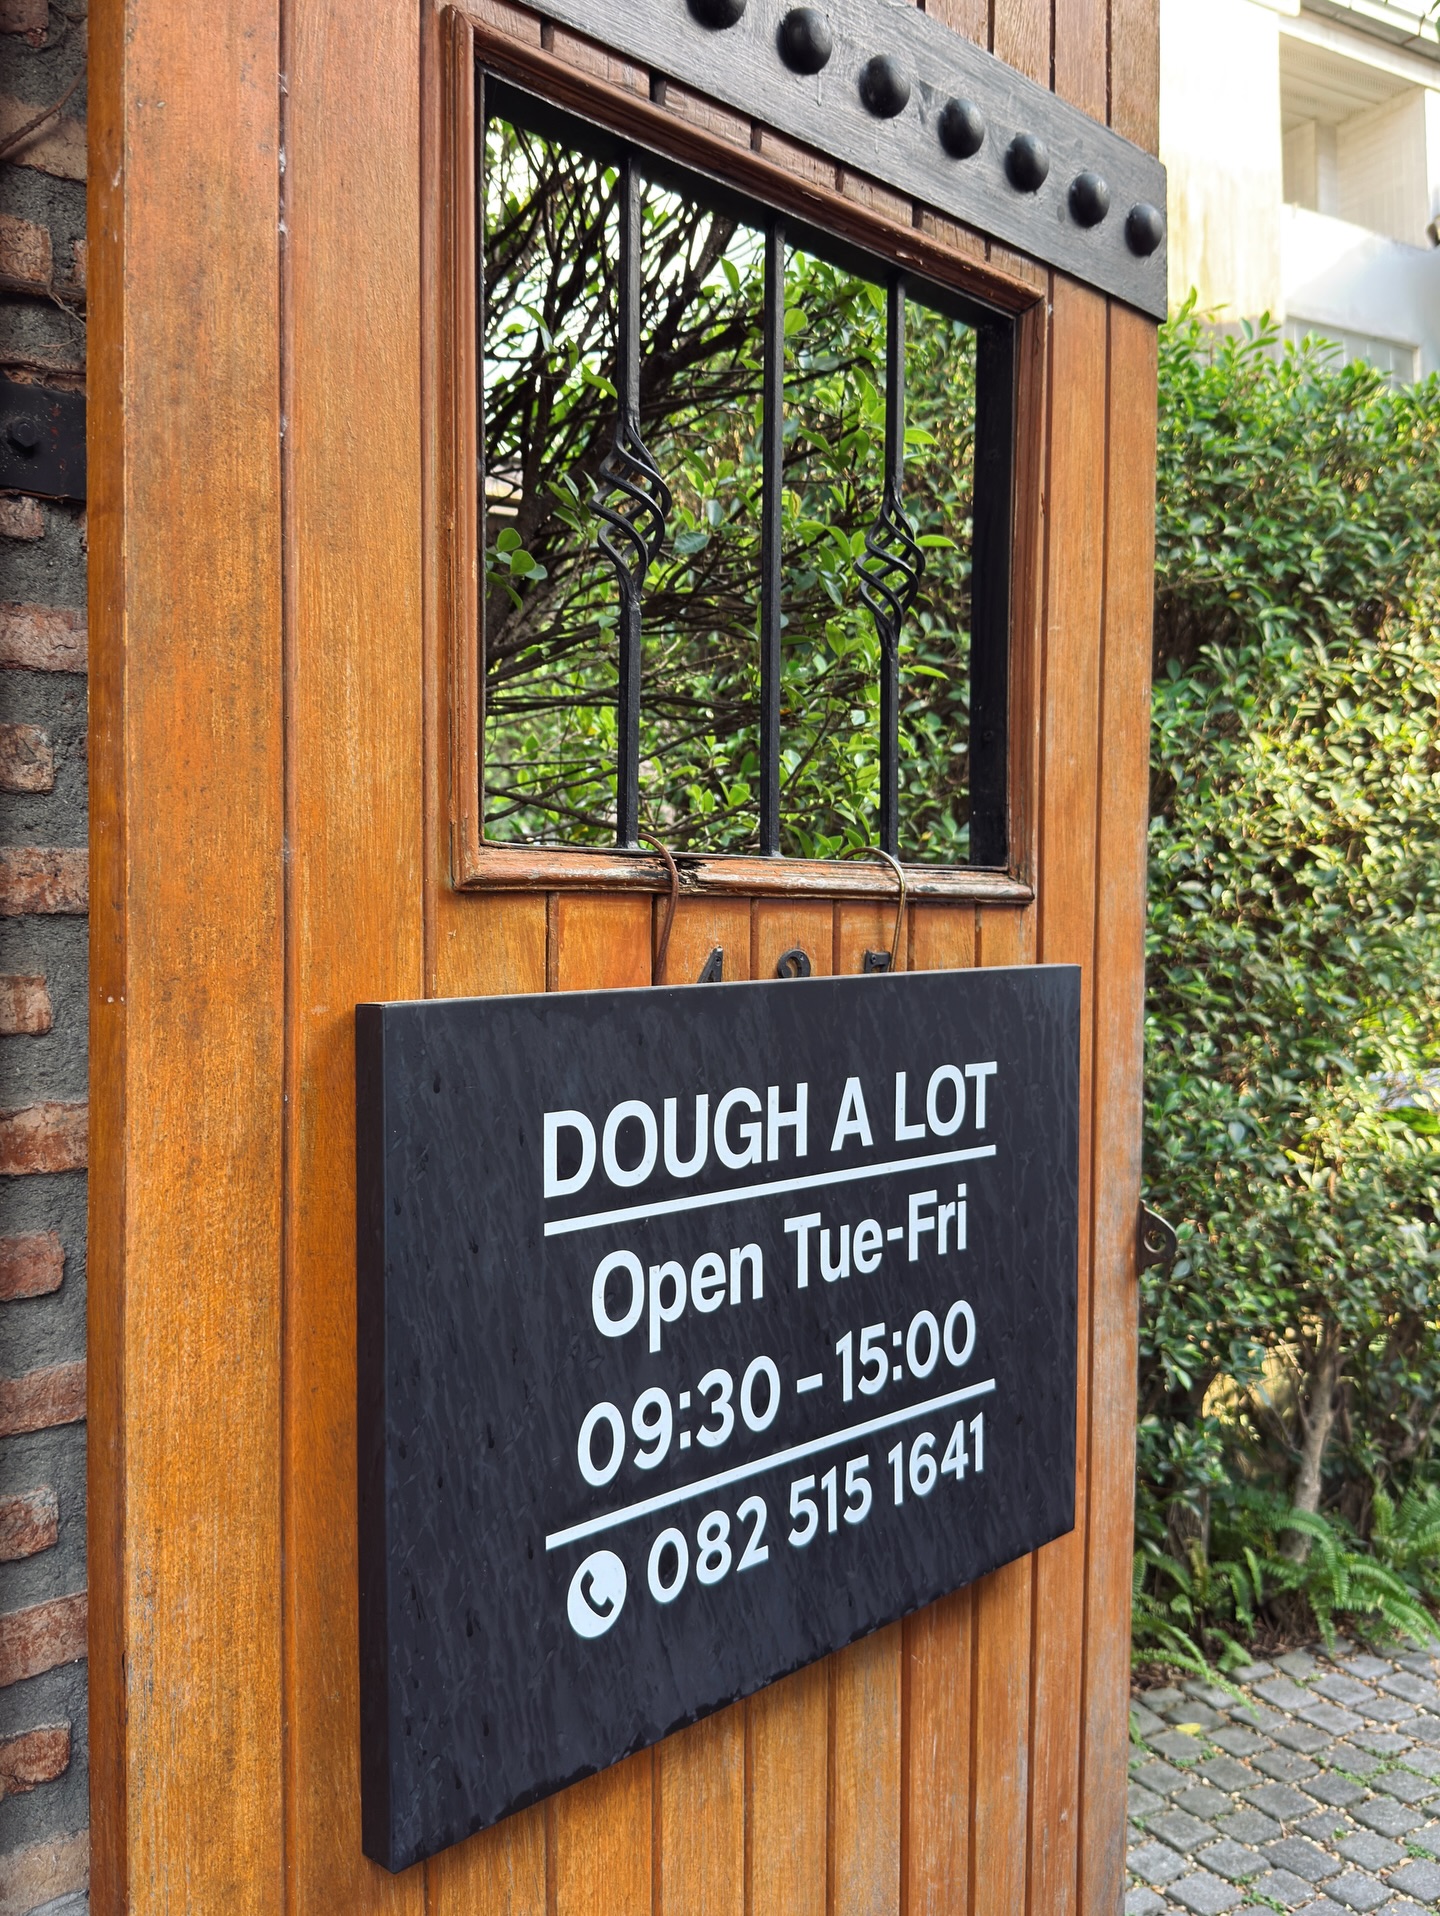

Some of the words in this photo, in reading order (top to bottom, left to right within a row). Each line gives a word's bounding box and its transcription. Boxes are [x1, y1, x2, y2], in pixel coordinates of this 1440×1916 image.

[543, 1082, 809, 1199] DOUGH
[830, 1076, 874, 1152] A
[894, 1060, 998, 1142] LOT
[591, 1243, 764, 1354] Open
[783, 1182, 967, 1289] Tue-Fri
[577, 1355, 781, 1487] 09:30
[835, 1299, 976, 1402] 15:00
[647, 1495, 769, 1604] 082
[787, 1454, 873, 1547] 515
[887, 1411, 984, 1506] 1641
